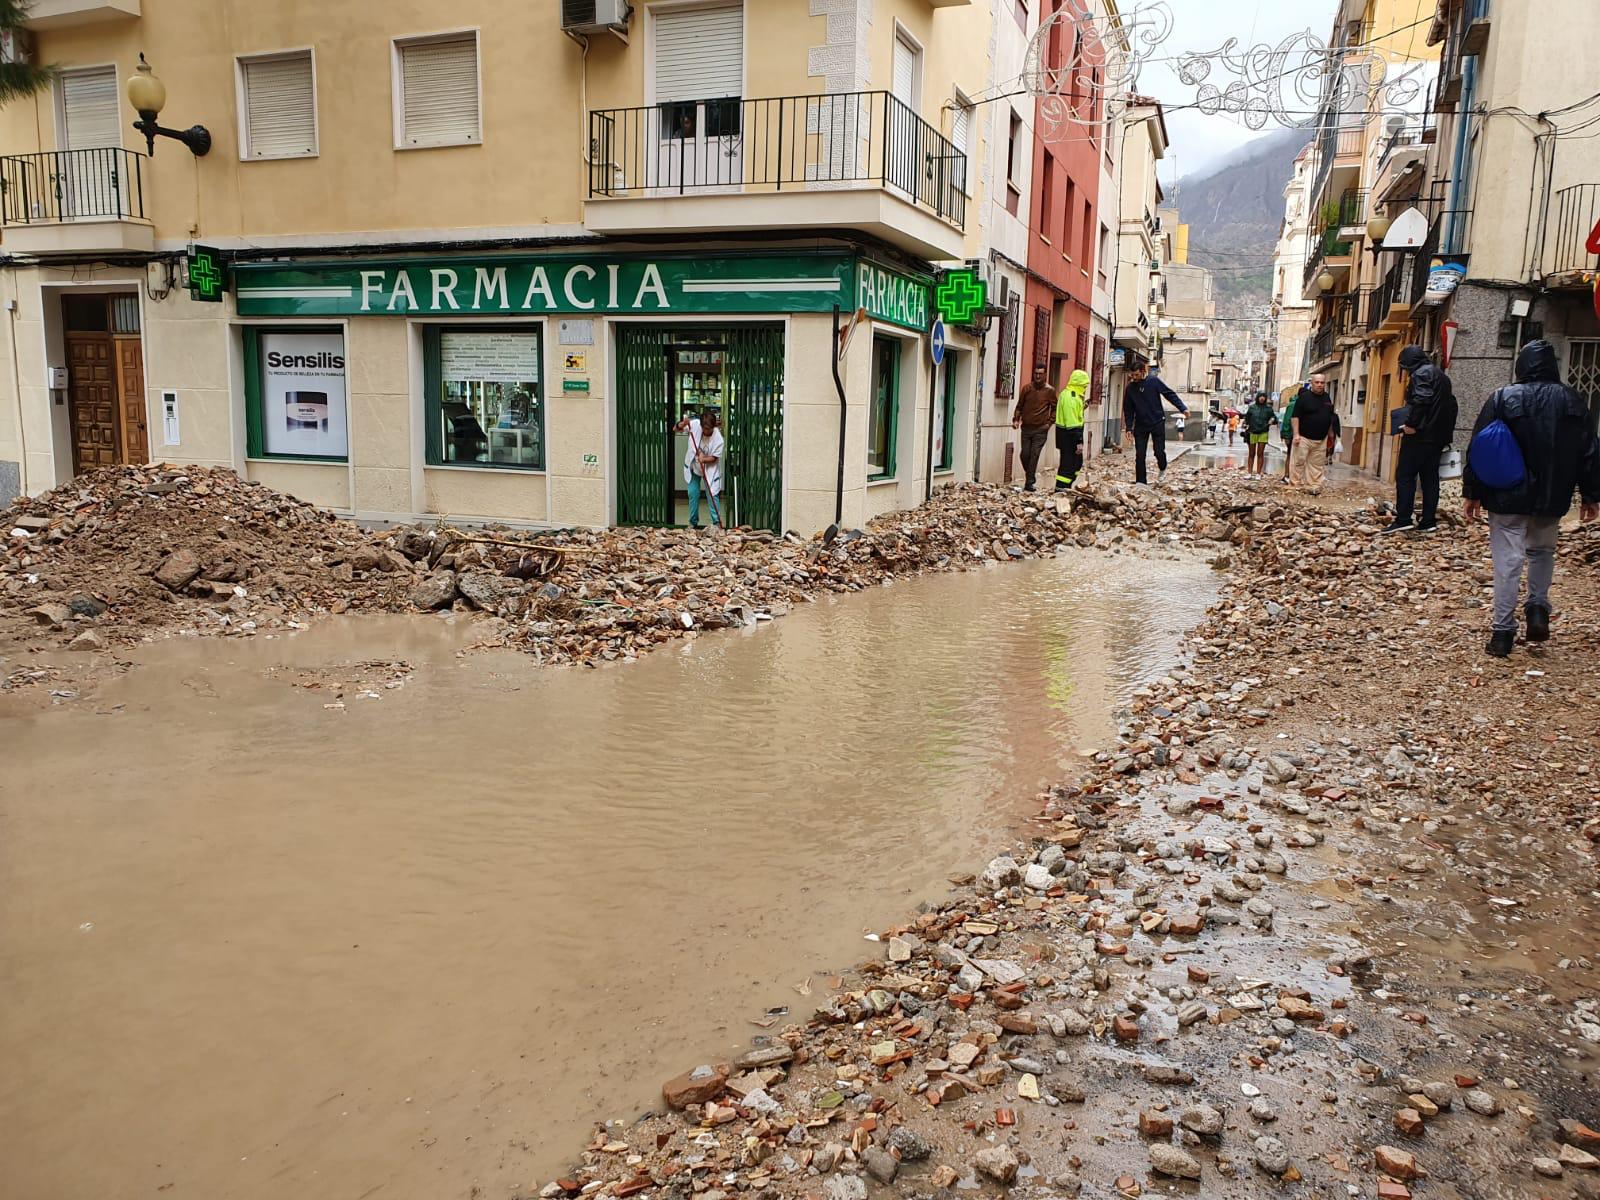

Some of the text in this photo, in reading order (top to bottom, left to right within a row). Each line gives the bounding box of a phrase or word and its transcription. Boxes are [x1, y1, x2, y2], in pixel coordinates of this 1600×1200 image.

[360, 263, 671, 311] FARMACIA
[859, 262, 926, 328] FARMACIA
[267, 351, 345, 369] Sensilis
